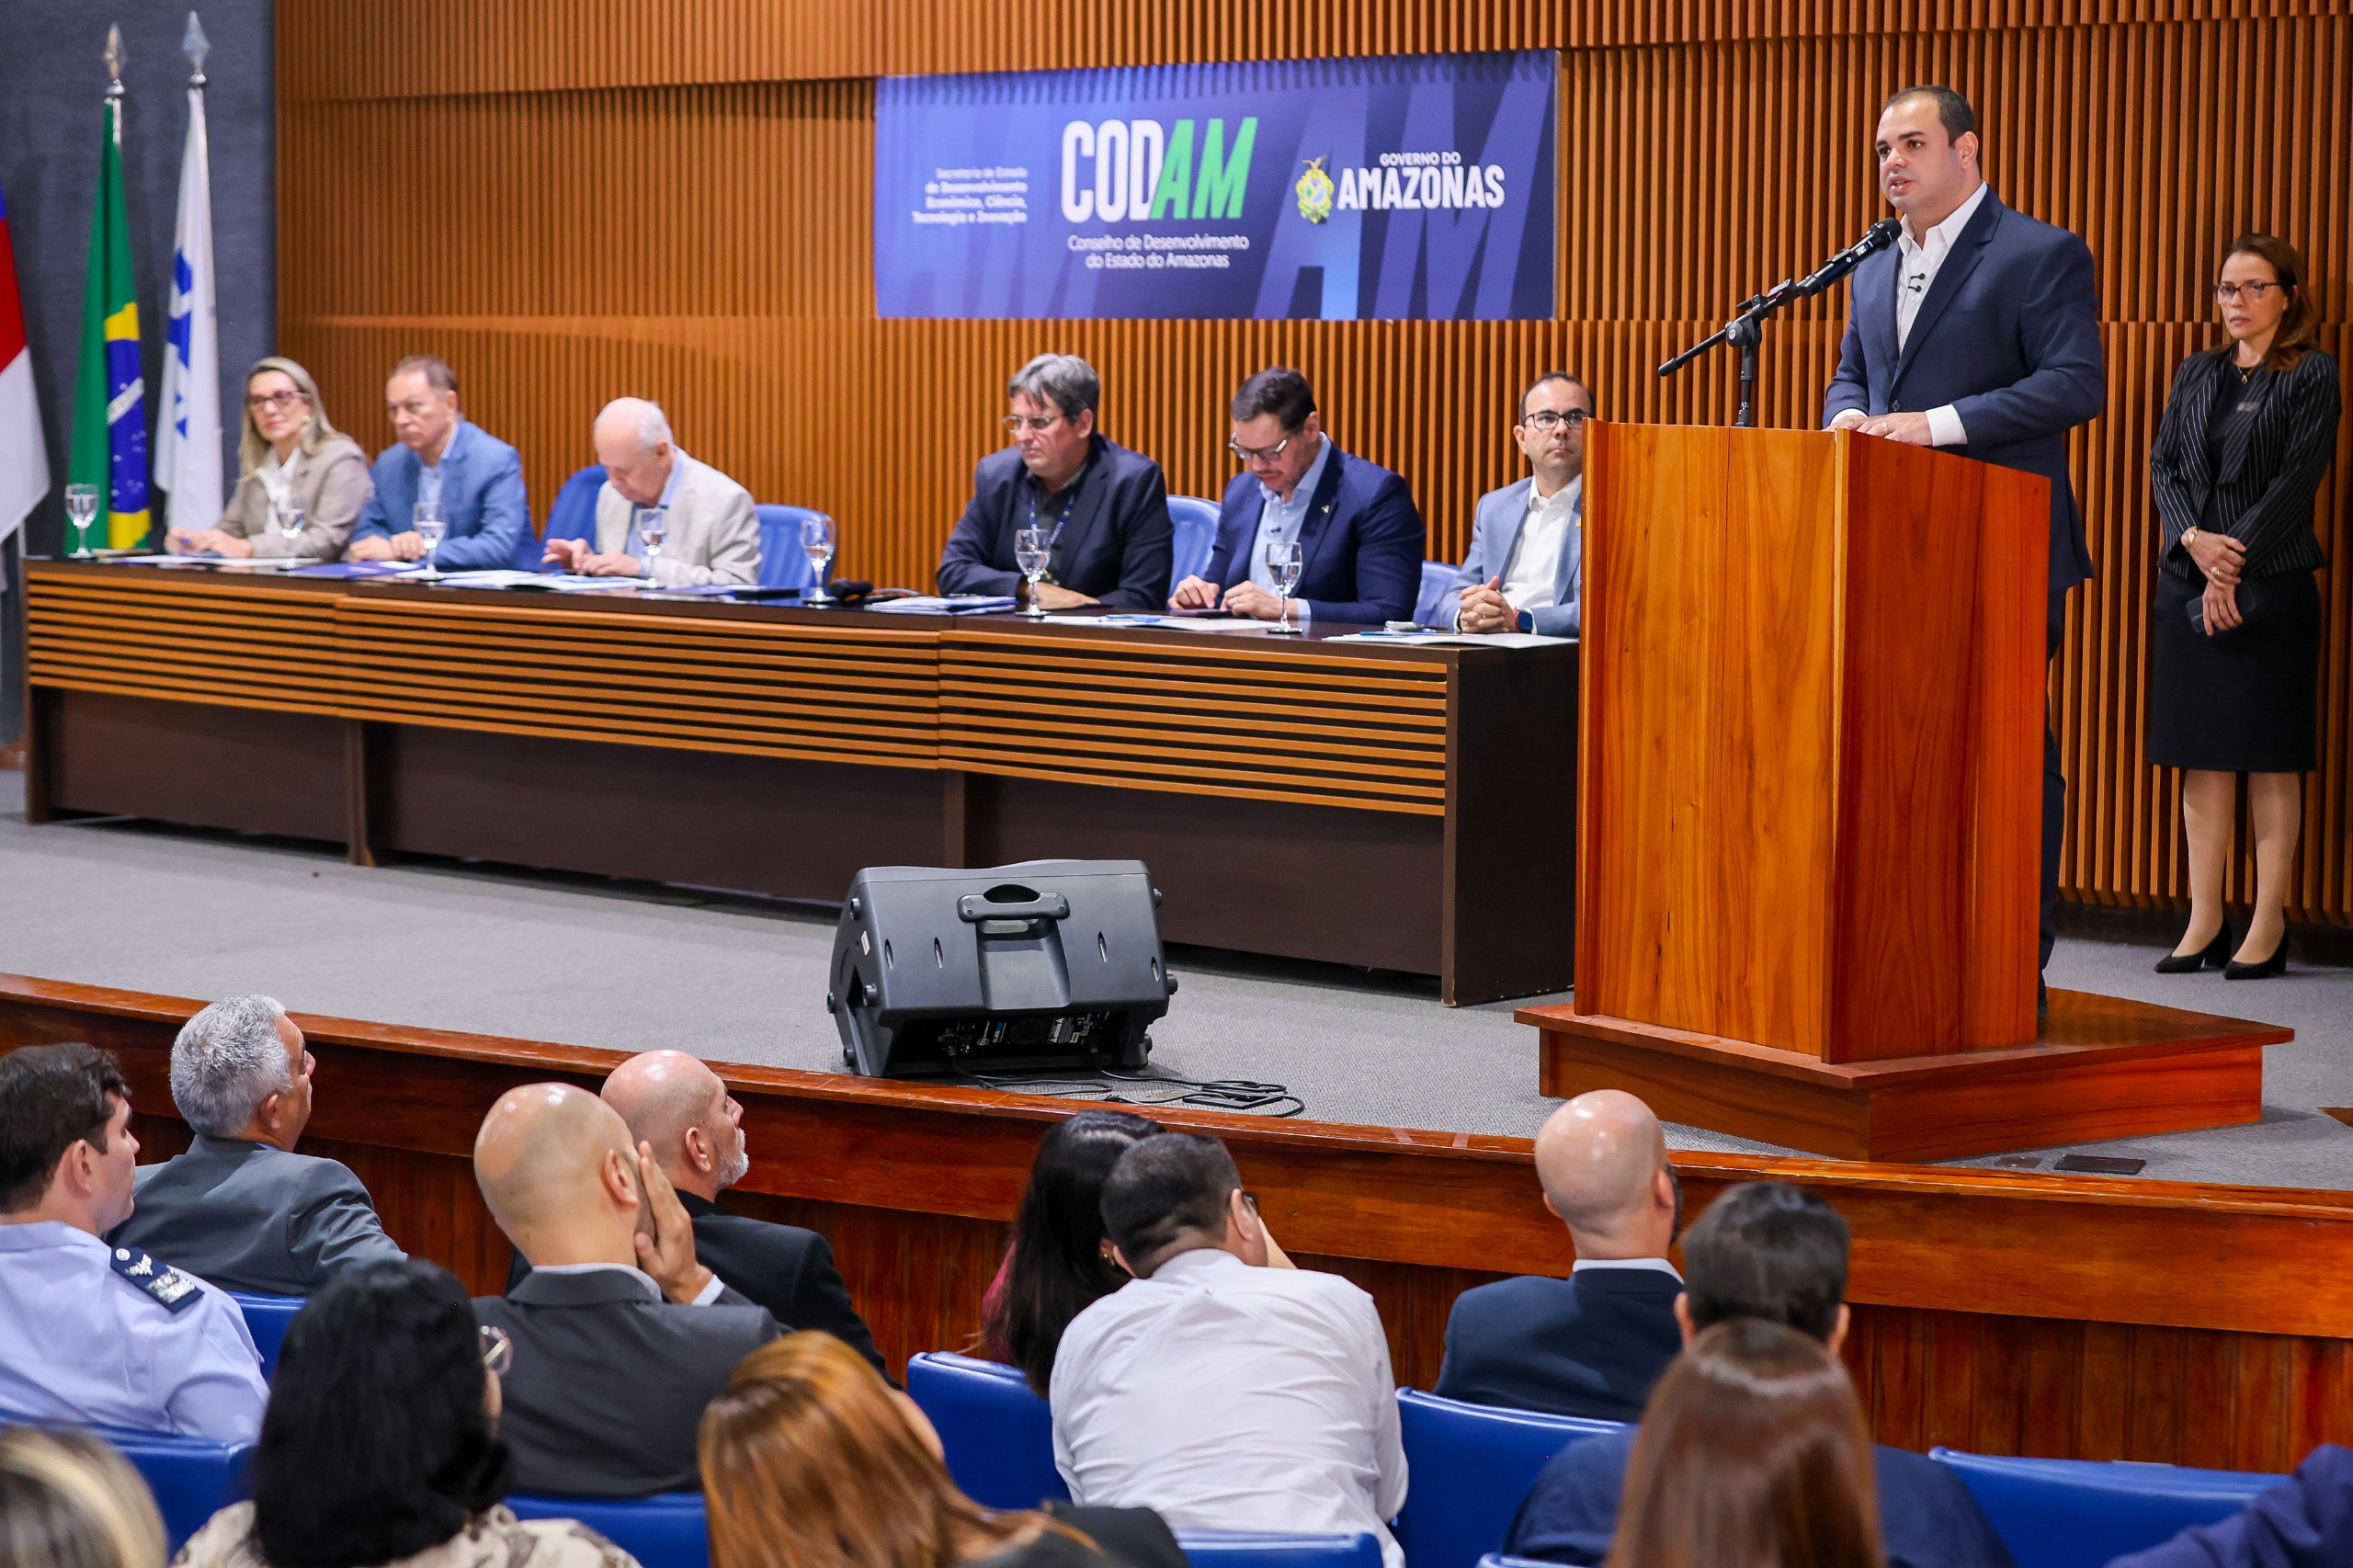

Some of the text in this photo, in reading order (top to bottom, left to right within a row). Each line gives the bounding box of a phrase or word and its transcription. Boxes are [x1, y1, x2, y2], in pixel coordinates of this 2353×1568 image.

[1380, 151, 1461, 167] GOVERNO DO
[1061, 117, 1258, 223] CODAM
[1336, 165, 1506, 210] AMAZONAS
[1067, 233, 1250, 251] Conselho de Desenvolvimento
[1086, 251, 1231, 269] do Estado do Amazonas
